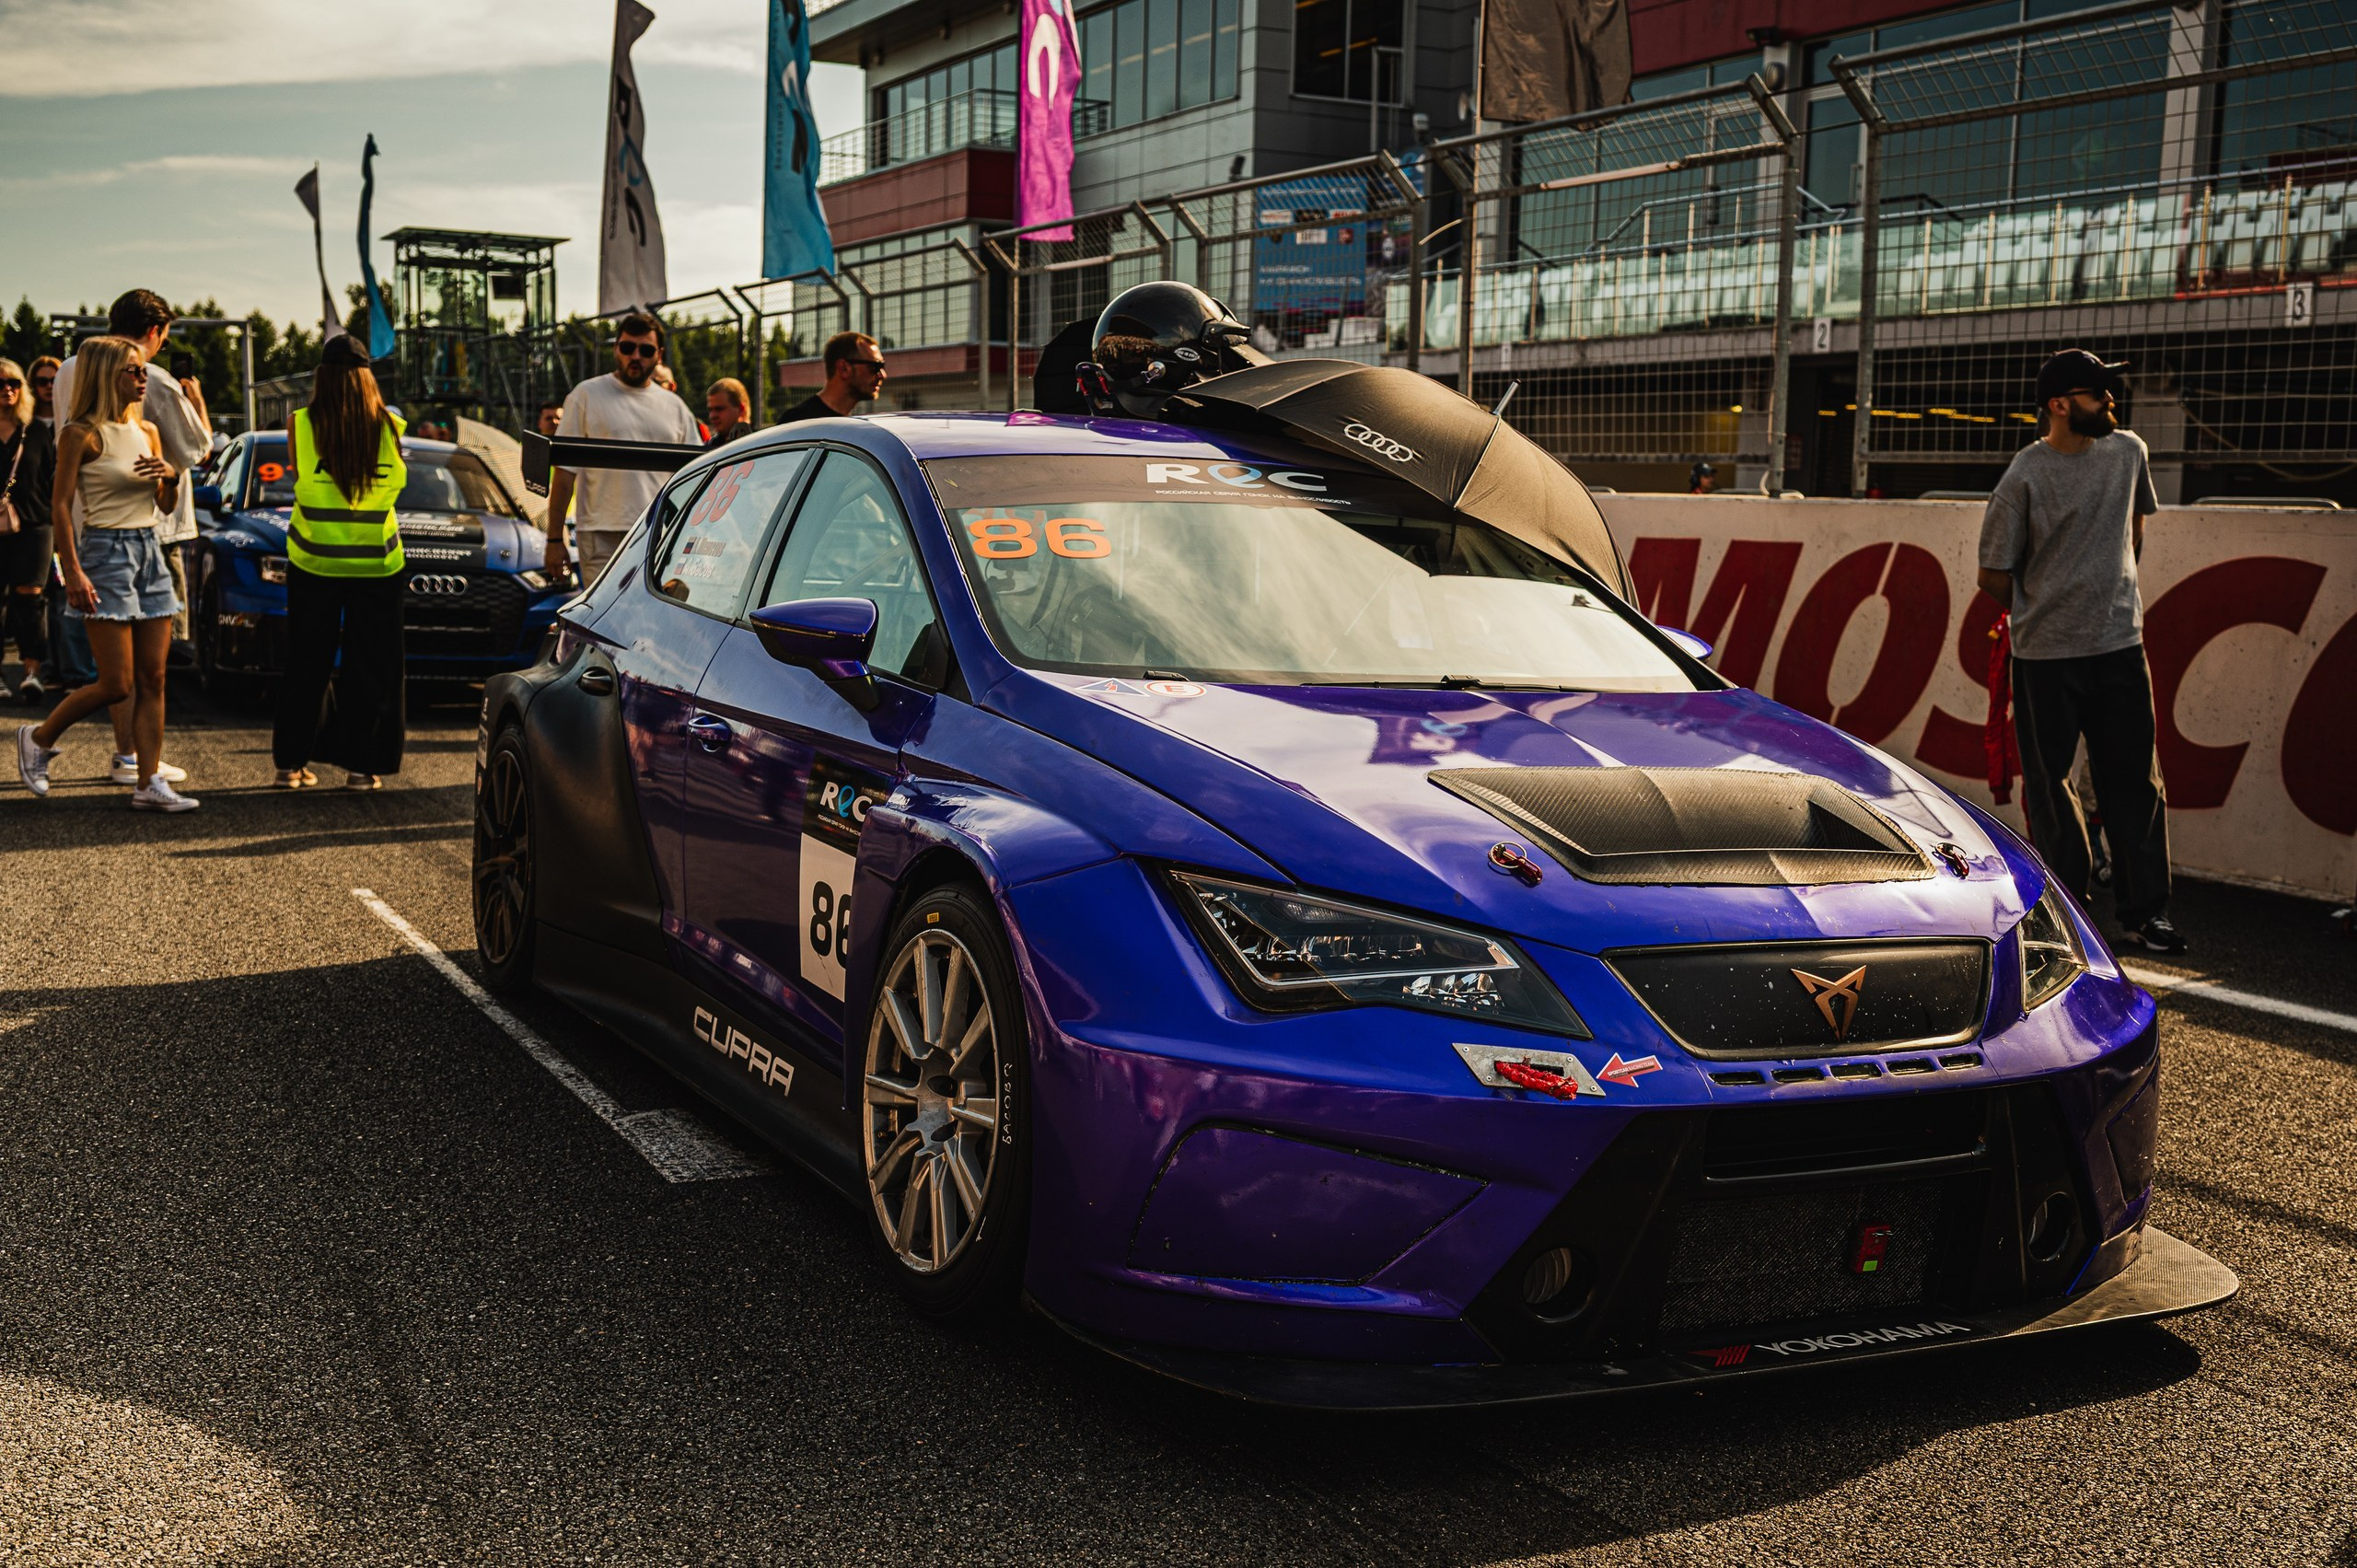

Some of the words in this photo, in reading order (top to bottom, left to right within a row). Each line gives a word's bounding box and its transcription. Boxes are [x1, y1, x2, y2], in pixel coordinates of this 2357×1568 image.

[2293, 289, 2305, 321] 3
[1817, 323, 1828, 349] 2
[691, 460, 755, 527] 86
[970, 518, 1112, 559] 86
[693, 1005, 795, 1098] CUPRA
[1754, 1321, 1971, 1356] YOKOHAMA
